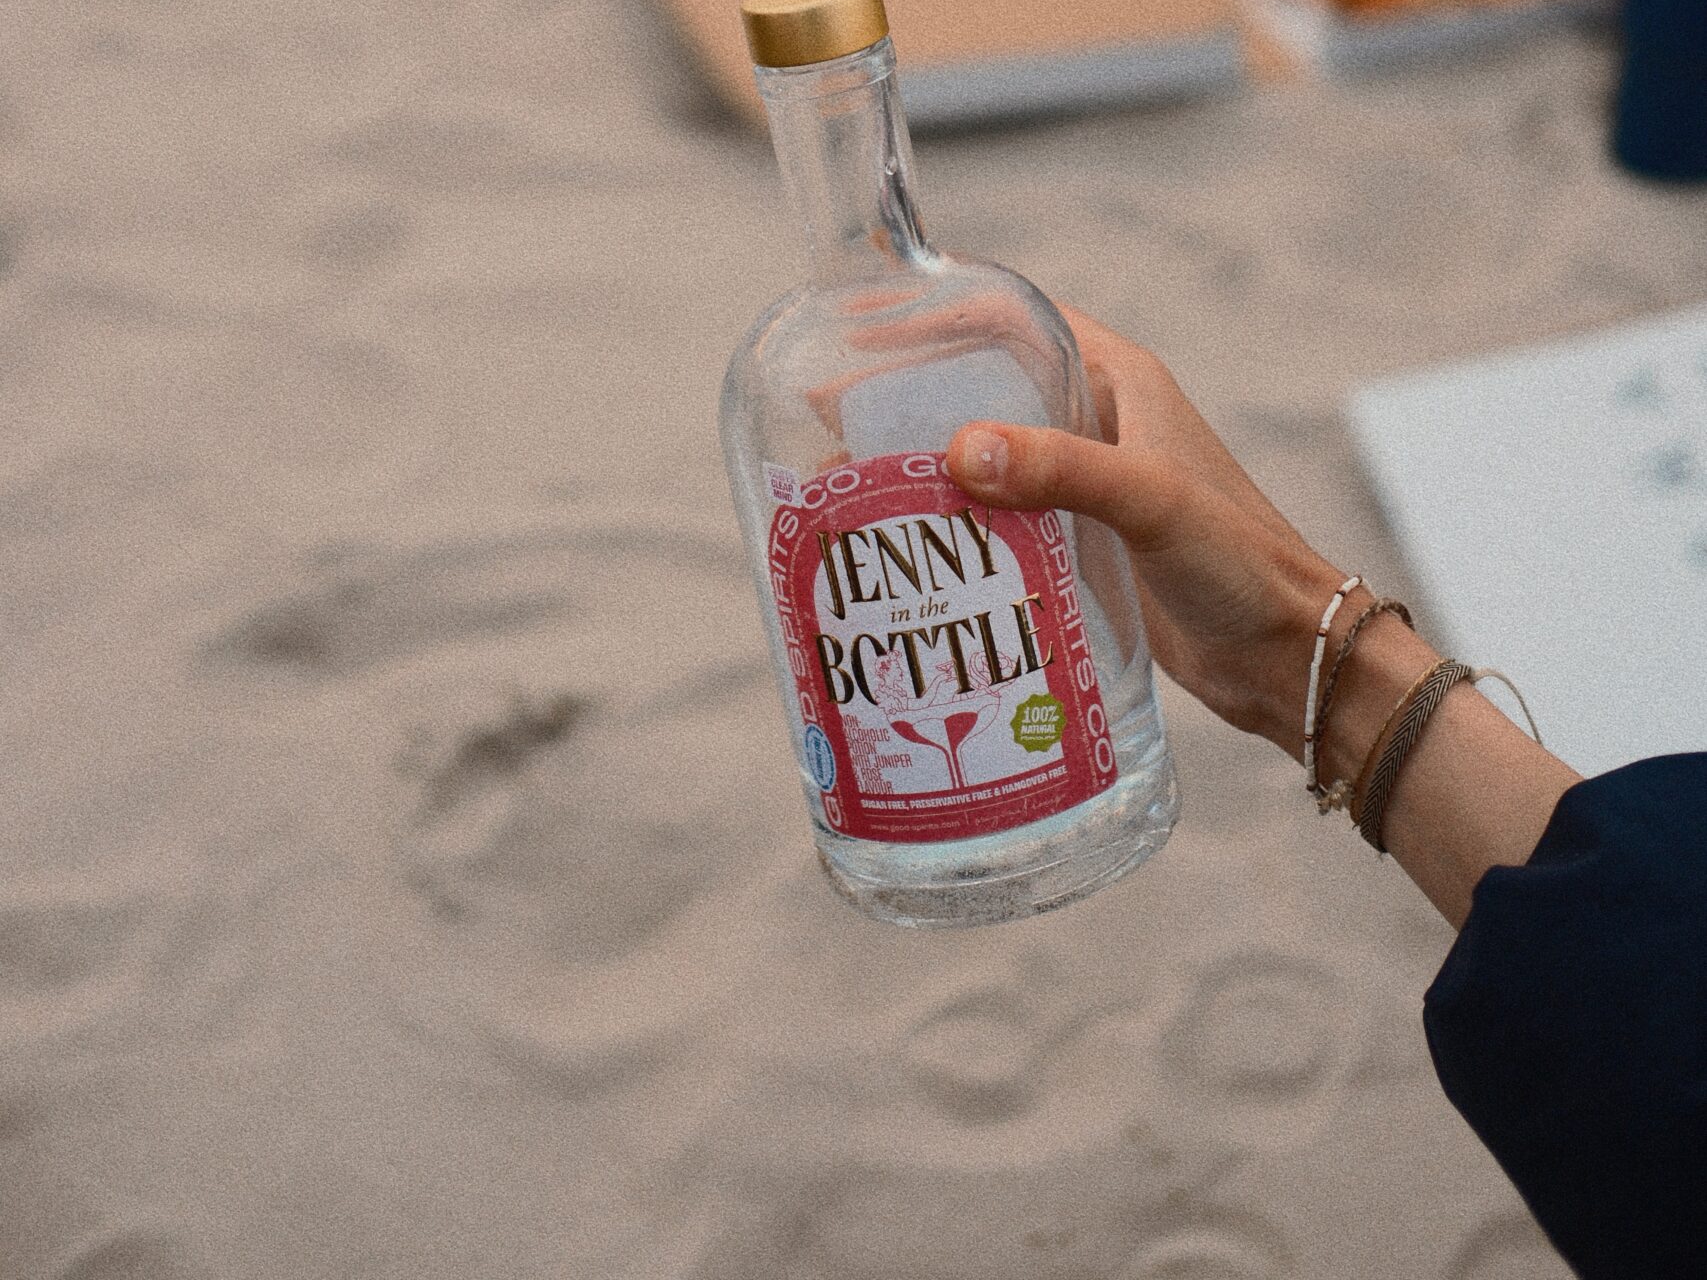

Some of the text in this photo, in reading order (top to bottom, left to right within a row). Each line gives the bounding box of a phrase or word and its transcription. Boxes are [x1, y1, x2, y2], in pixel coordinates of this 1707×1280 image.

[770, 510, 807, 678] SPIRITS
[800, 469, 873, 510] CO.
[816, 506, 1000, 620] JENNY
[890, 596, 949, 623] in the
[815, 592, 1054, 706] BOTTLE
[1040, 510, 1095, 692] SPIRITS
[1087, 703, 1113, 786] CO.
[1021, 724, 1056, 734] NATURAL
[1022, 705, 1060, 724] 100%
[874, 754, 912, 768] JUNIPER
[859, 779, 894, 795] LAVOUR
[861, 765, 1068, 811] SUGAR FREE, PRESERVATIVE FREE & HANGOVER FREE
